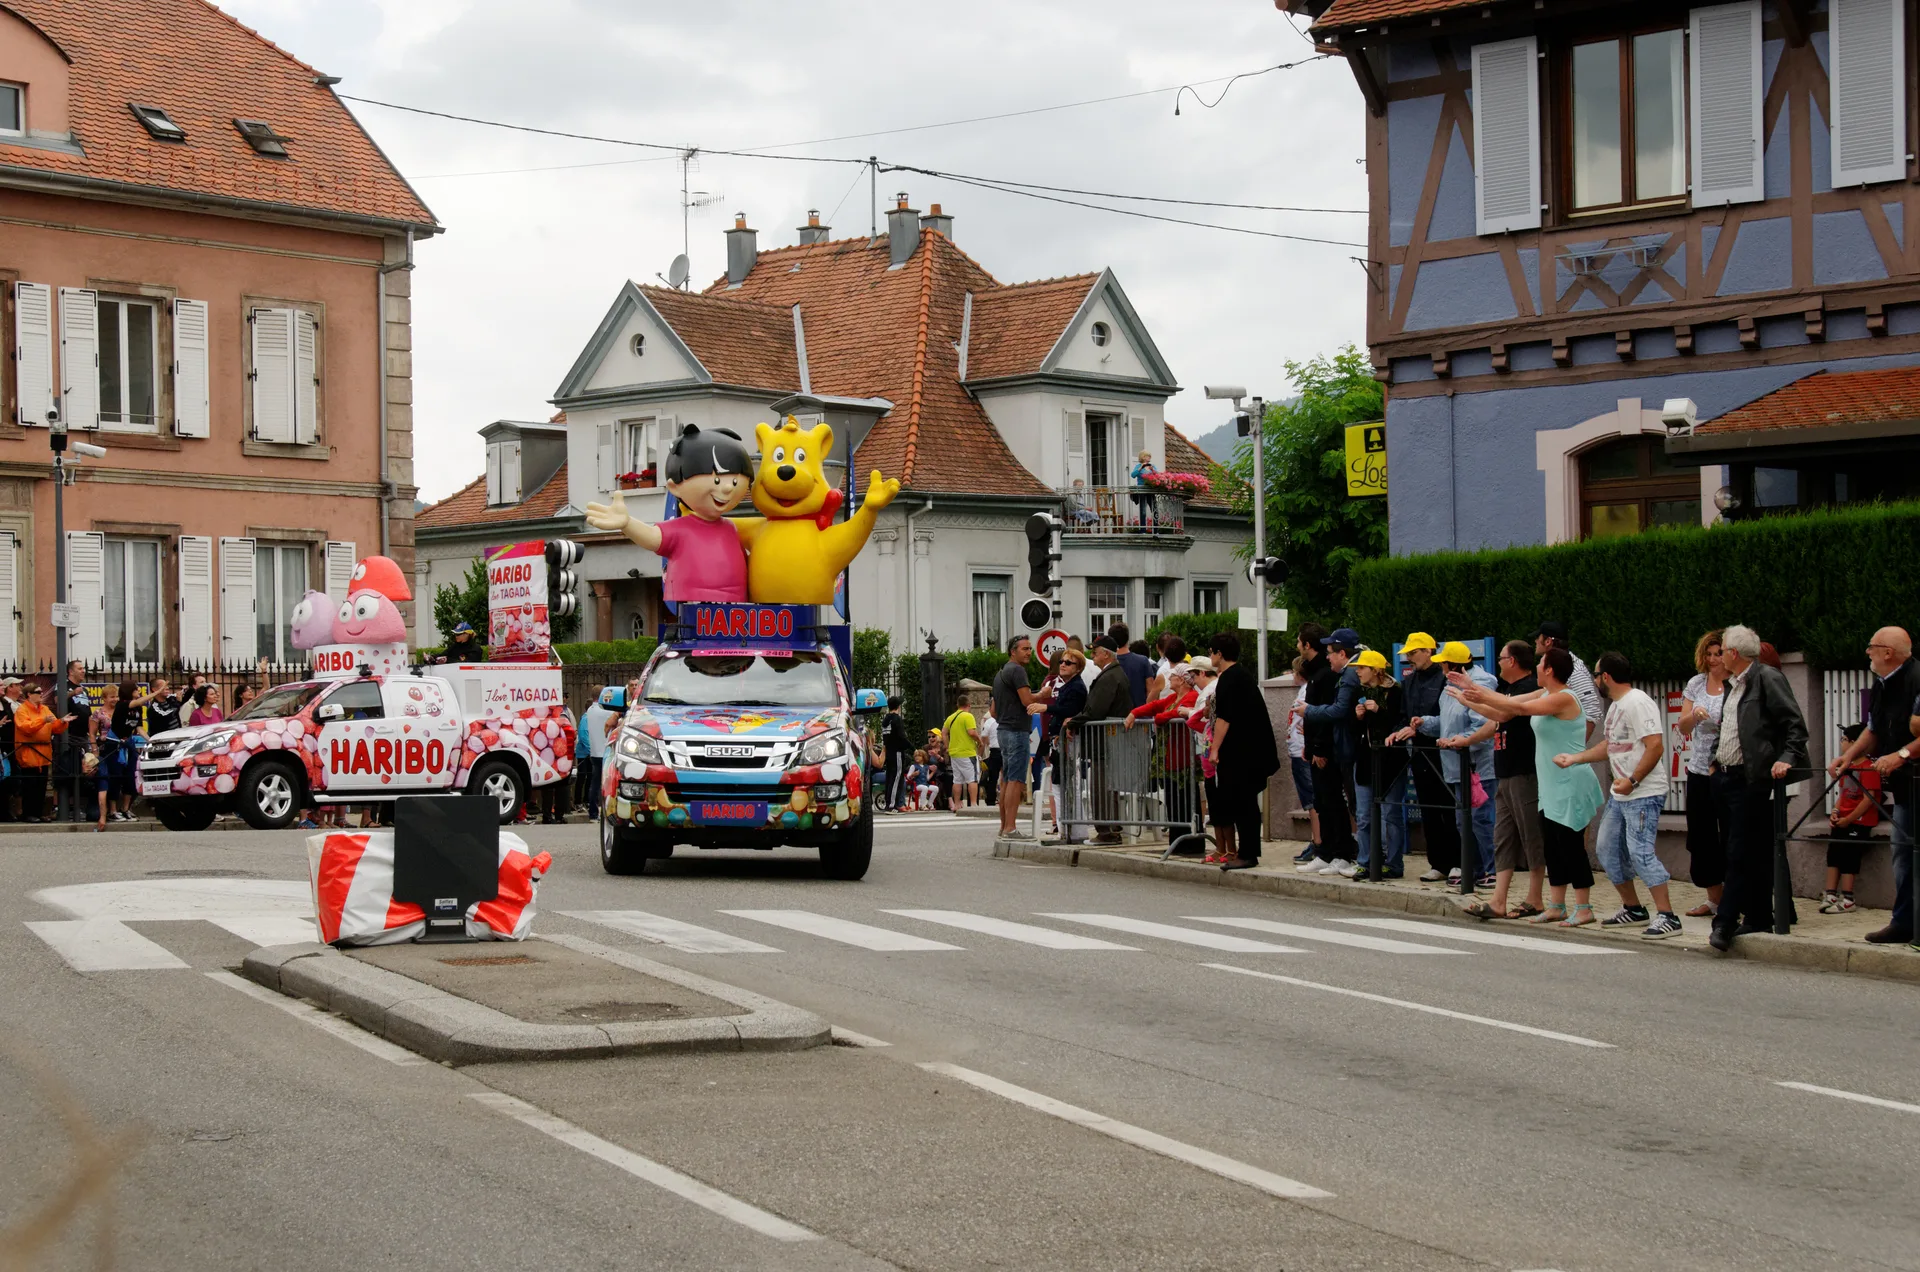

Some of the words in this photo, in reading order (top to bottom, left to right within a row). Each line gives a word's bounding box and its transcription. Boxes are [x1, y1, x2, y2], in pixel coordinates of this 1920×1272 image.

[489, 563, 532, 586] HARIBO
[500, 586, 530, 599] TAGADA
[696, 607, 793, 637] HARIBO
[314, 650, 354, 673] ARIBO
[510, 688, 558, 702] TAGADA
[330, 738, 445, 775] HARIBO
[707, 747, 752, 756] ISUZU
[702, 803, 755, 819] HARIBO
